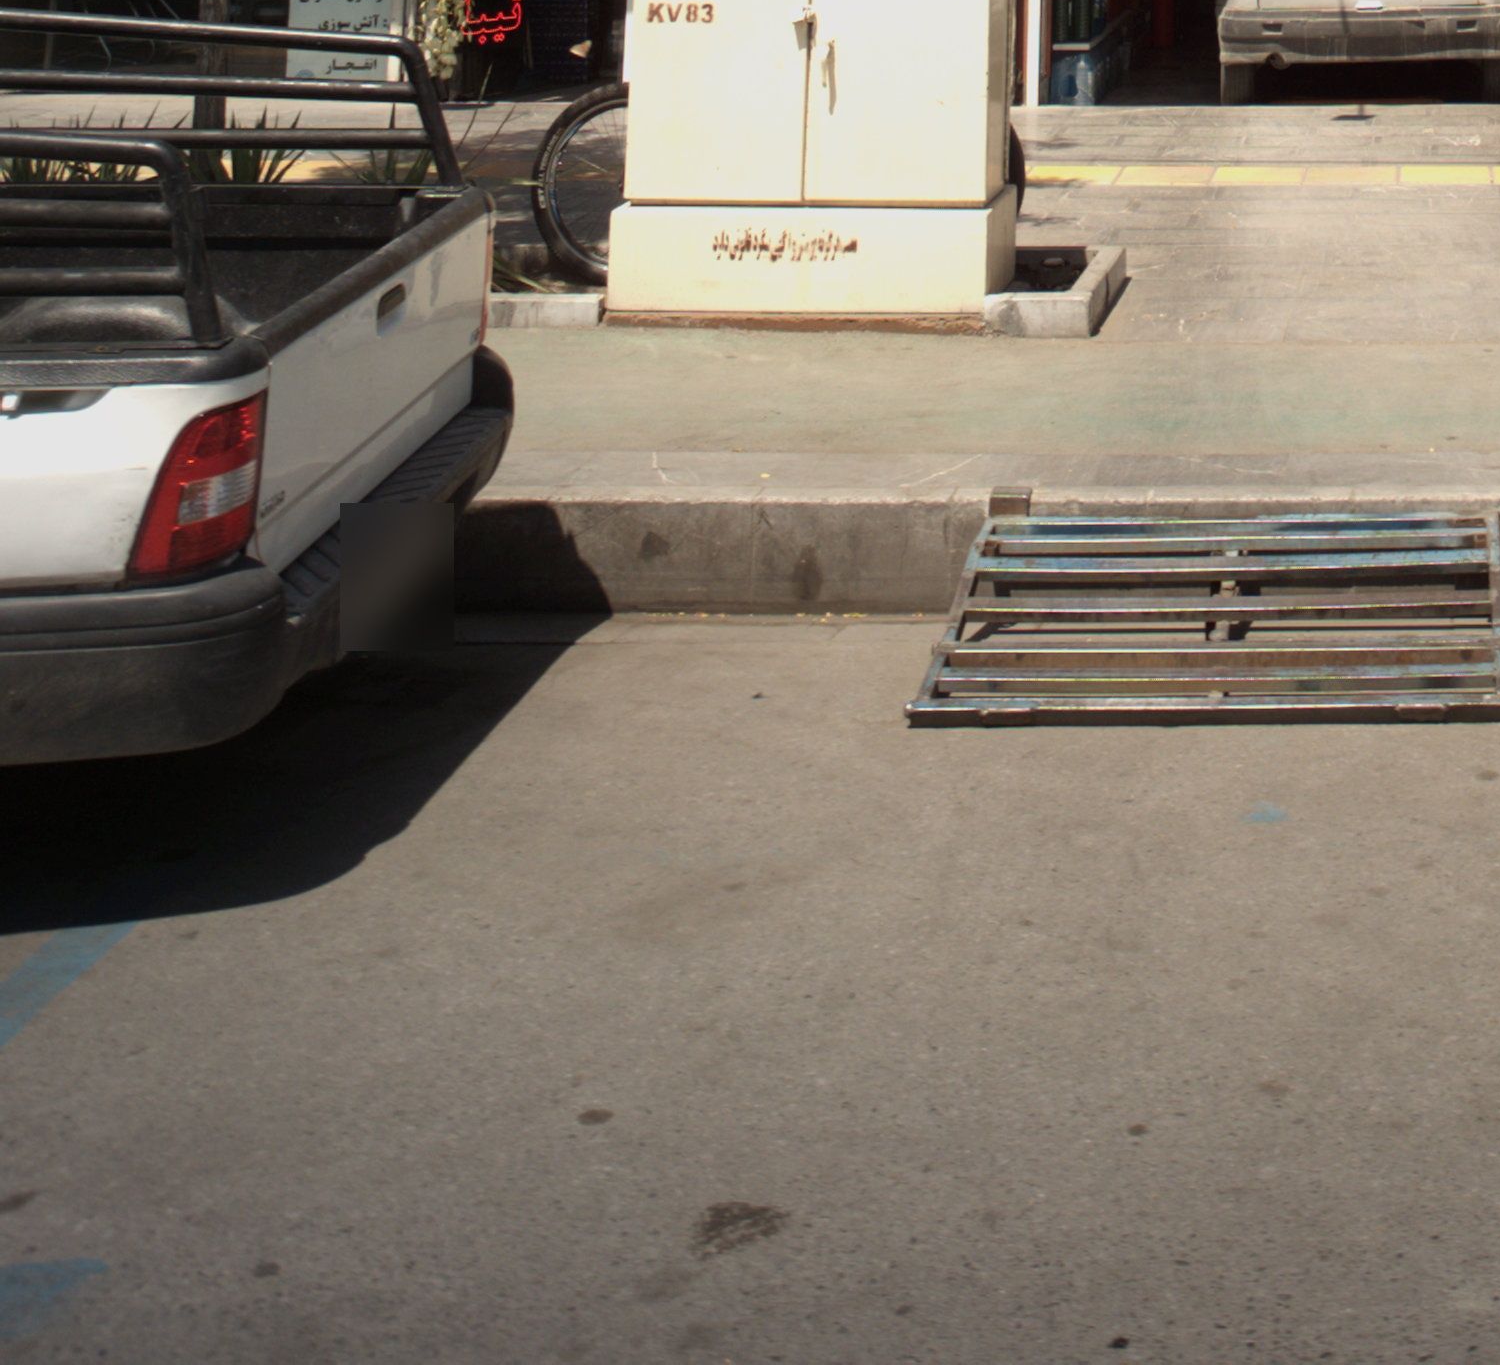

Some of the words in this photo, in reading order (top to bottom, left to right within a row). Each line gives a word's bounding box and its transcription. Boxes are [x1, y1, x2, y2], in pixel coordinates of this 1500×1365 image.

[646, 2, 714, 25] KV83
[318, 19, 350, 32] سوزی
[353, 14, 379, 32] آتش
